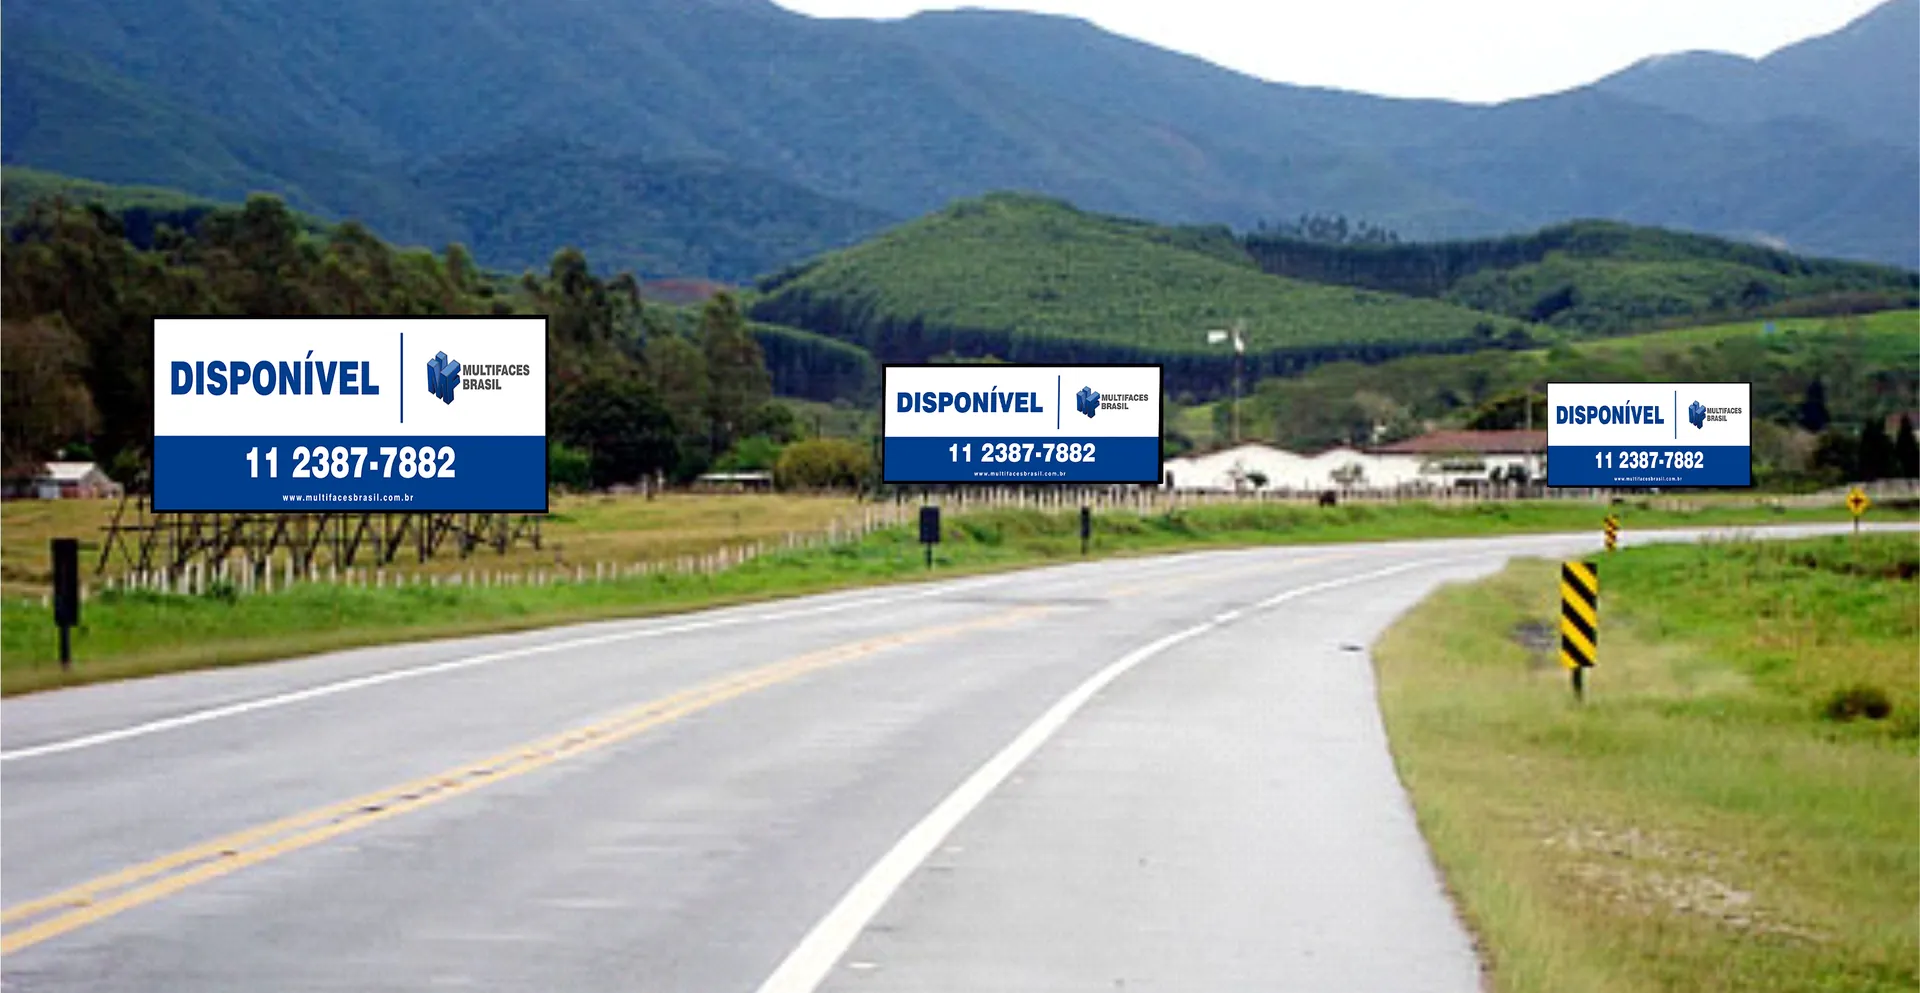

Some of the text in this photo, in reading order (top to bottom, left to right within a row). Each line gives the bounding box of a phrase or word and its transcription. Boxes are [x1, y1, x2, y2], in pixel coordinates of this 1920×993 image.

[171, 350, 379, 396] DISPONÍVEL
[463, 364, 530, 376] MULTIFACES
[463, 379, 501, 390] BRASIL
[897, 386, 1043, 413] DISPONÍVEL
[1101, 394, 1149, 402] MULTIFACES
[1101, 402, 1129, 410] BRASIL
[1557, 400, 1664, 424] DISPONÍVEL
[949, 443, 1095, 462] 11 2387-7882
[1596, 451, 1703, 469] 11 2387-7882
[247, 446, 455, 478] 11 2387-7882
[282, 493, 414, 502] www.multifacesbrasil.com.br
